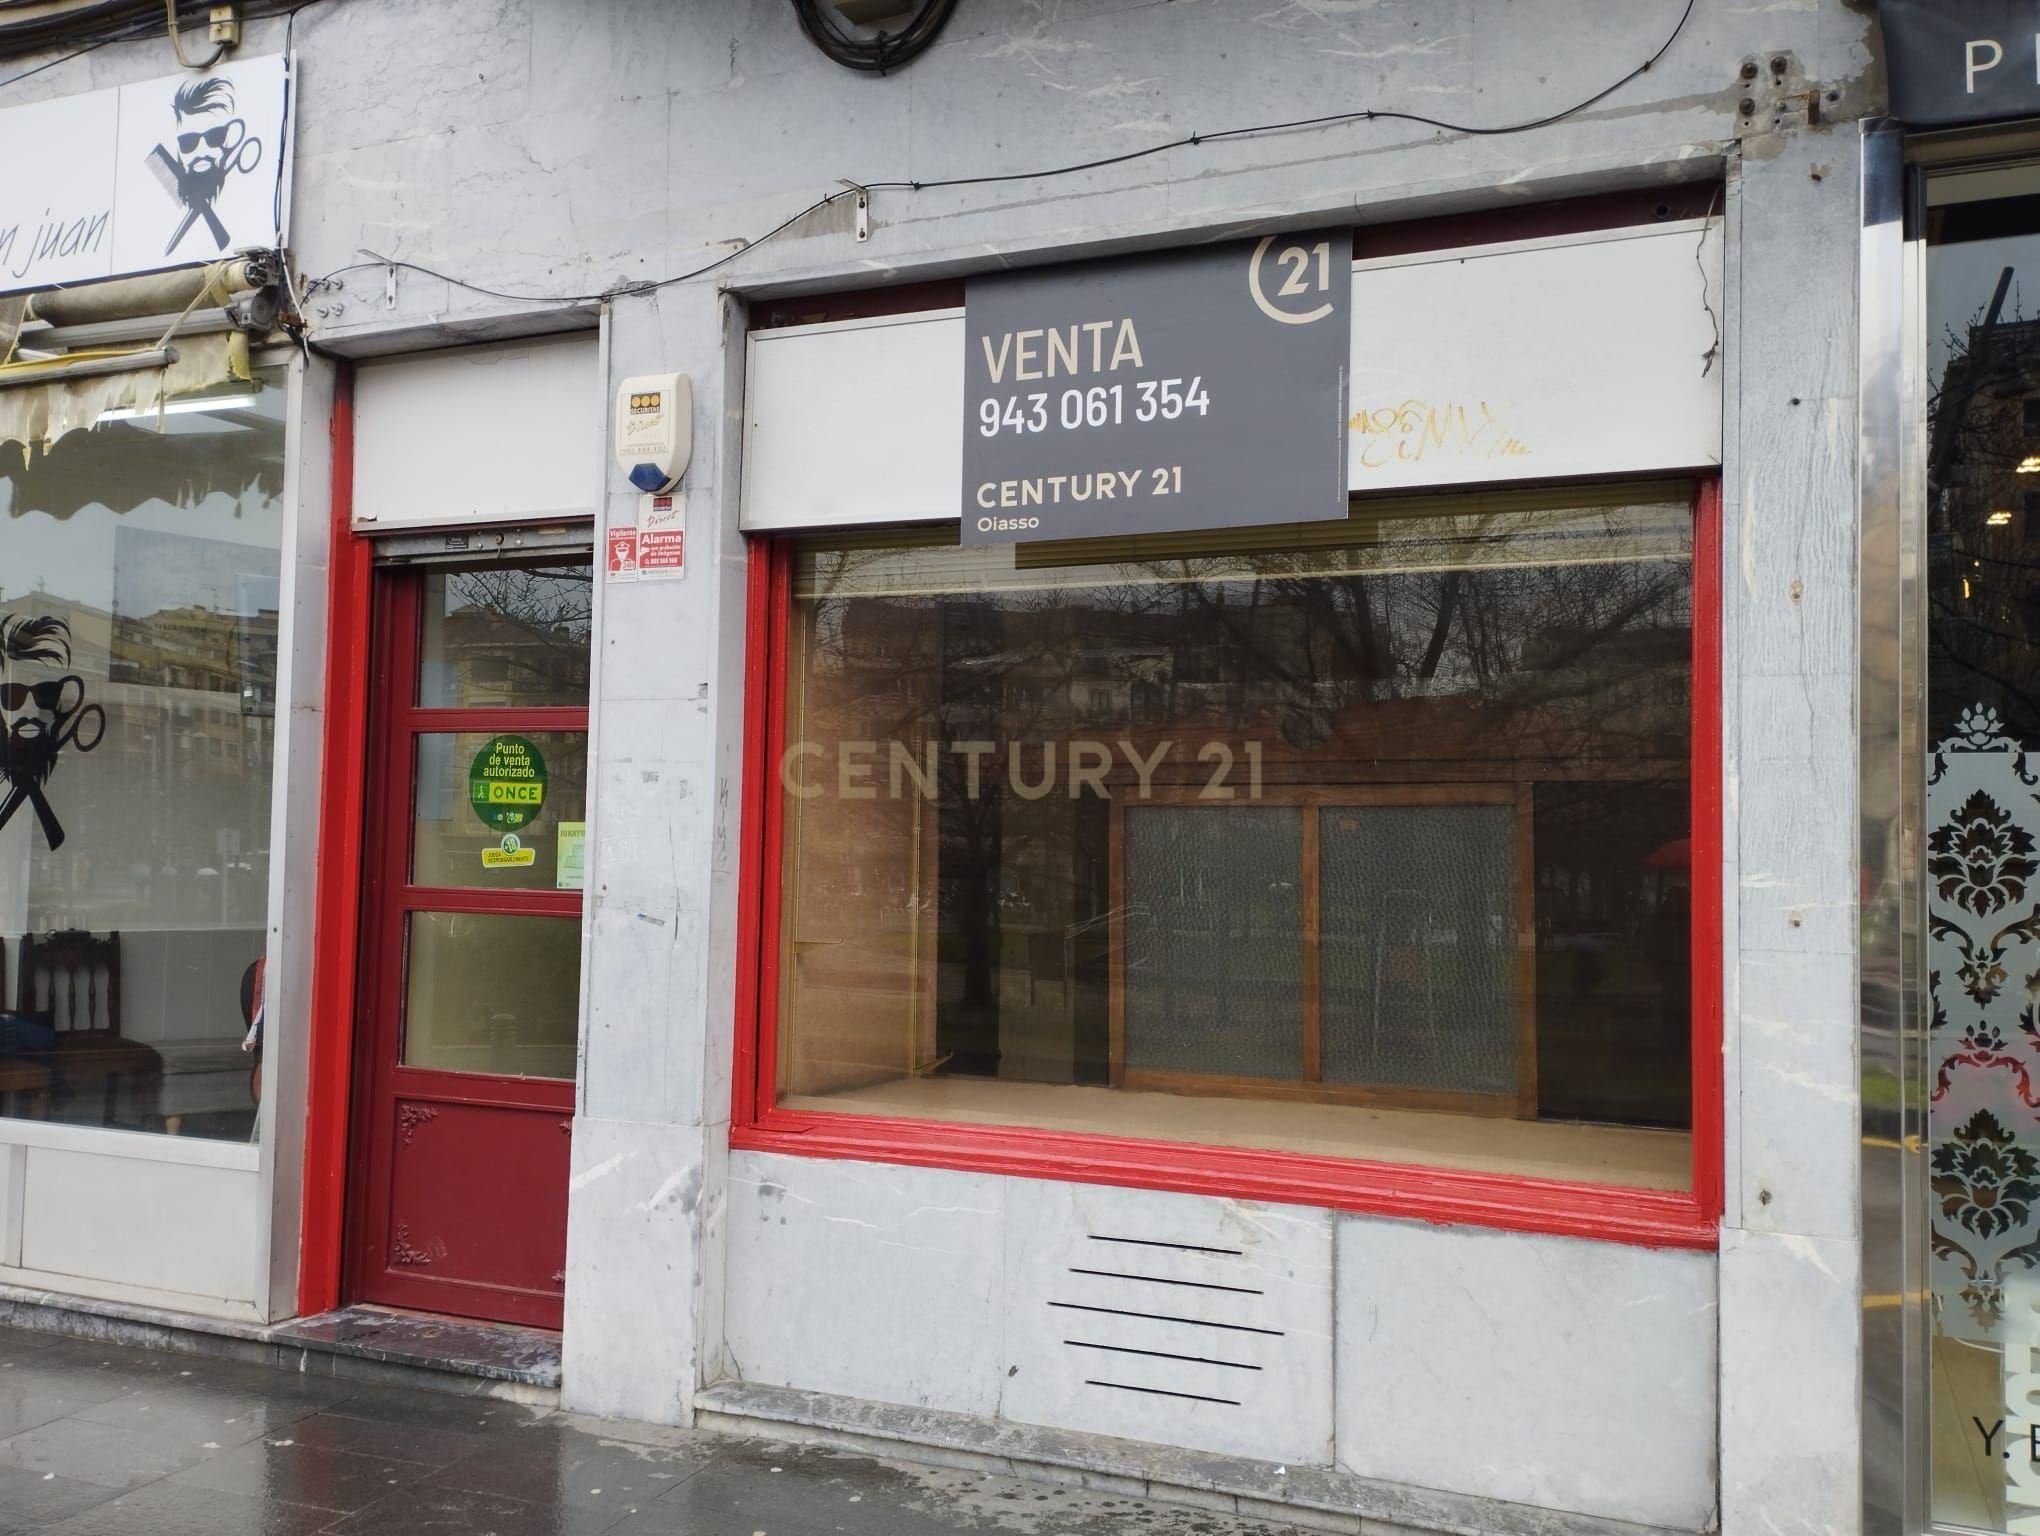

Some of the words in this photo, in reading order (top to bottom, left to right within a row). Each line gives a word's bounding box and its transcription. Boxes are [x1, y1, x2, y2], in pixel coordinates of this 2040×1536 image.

[12, 207, 110, 278] juan
[982, 318, 1143, 384] VENTA
[630, 406, 661, 415] SECURITAS
[979, 392, 1049, 437] 943
[1060, 384, 1123, 429] 061
[1136, 376, 1210, 422] 354
[976, 469, 1143, 508] CENTURY
[1151, 466, 1182, 495] 21
[647, 510, 681, 528] Direct
[977, 515, 1040, 532] Oiasso
[609, 529, 637, 538] Vigilante
[641, 533, 682, 545] Alarma
[495, 742, 525, 755] Punto
[489, 753, 501, 766] de
[504, 756, 531, 767] venta
[483, 765, 535, 778] autorizado
[493, 786, 538, 801] ONCE
